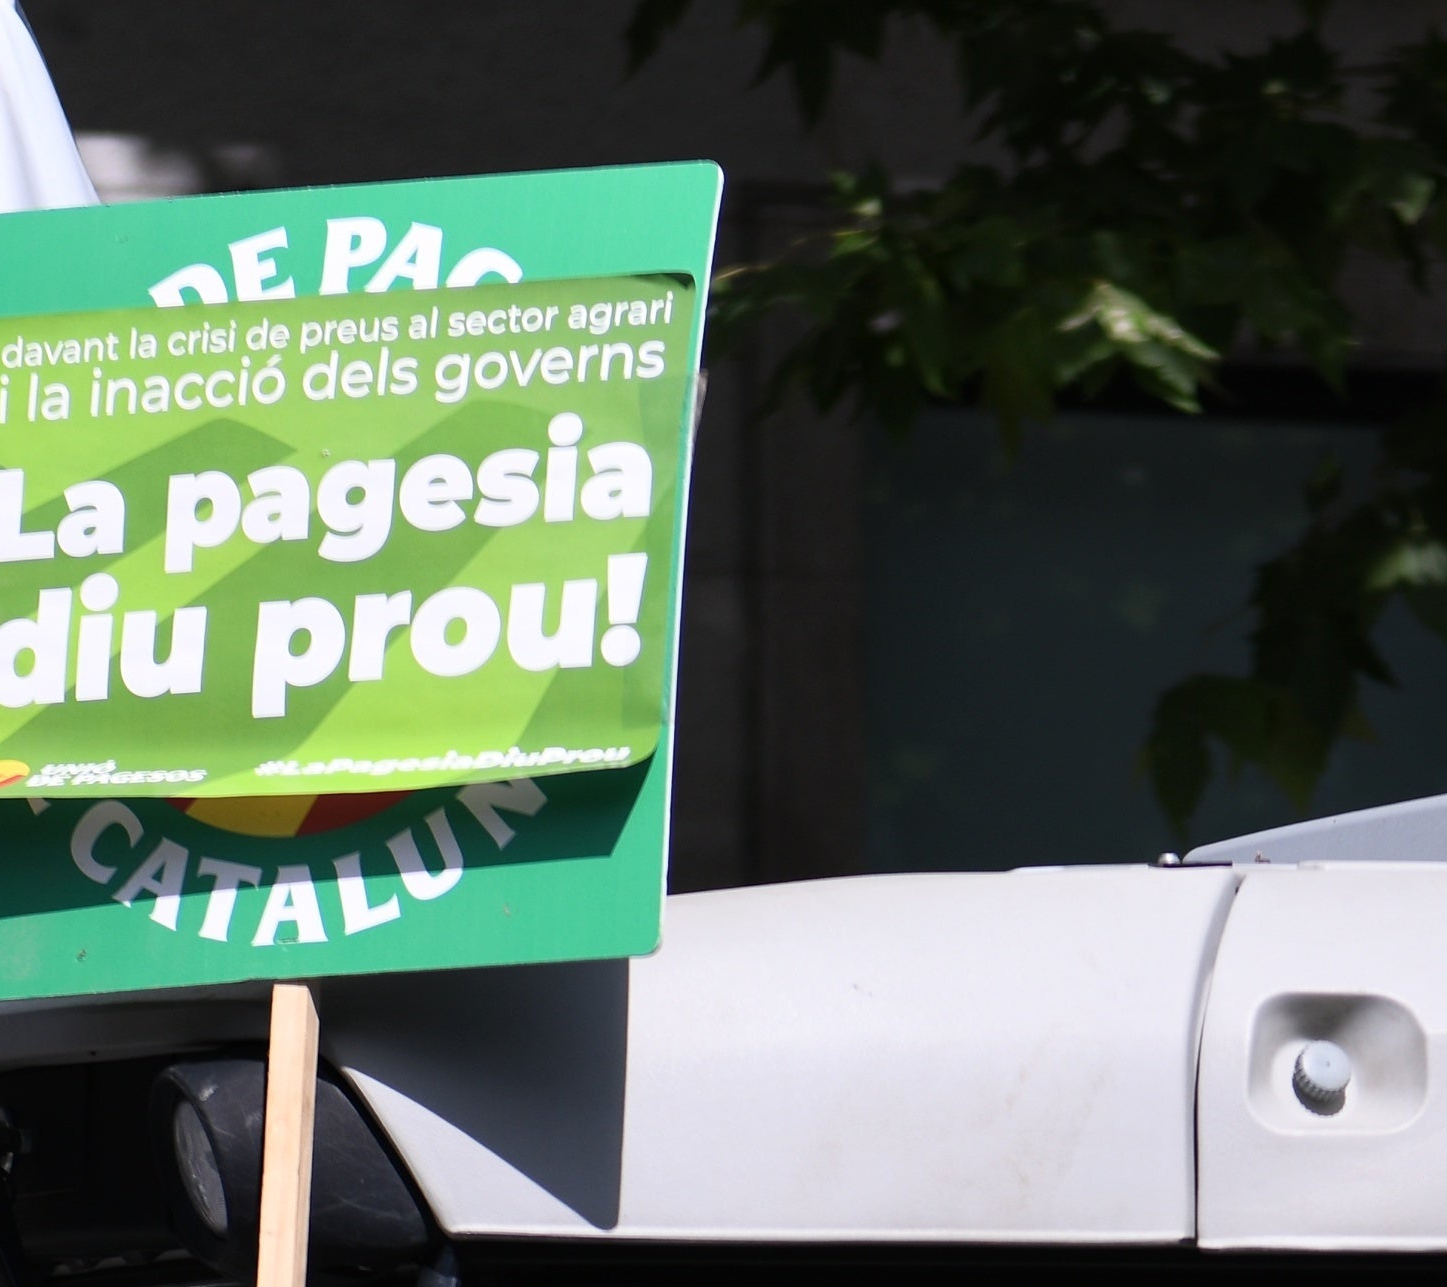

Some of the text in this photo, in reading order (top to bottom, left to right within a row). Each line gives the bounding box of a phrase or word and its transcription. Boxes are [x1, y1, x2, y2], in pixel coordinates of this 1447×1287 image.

[0, 292, 674, 368] davant la crisi de preus al sector agrari
[26, 373, 70, 421] la
[90, 354, 287, 417] inacció
[302, 347, 419, 401] dels
[434, 338, 667, 403] governs
[163, 412, 654, 574] pagesia
[251, 552, 648, 719] prou!
[72, 769, 208, 786] PAGESOS
[255, 746, 632, 777] #LaPagesiaDiuProu
